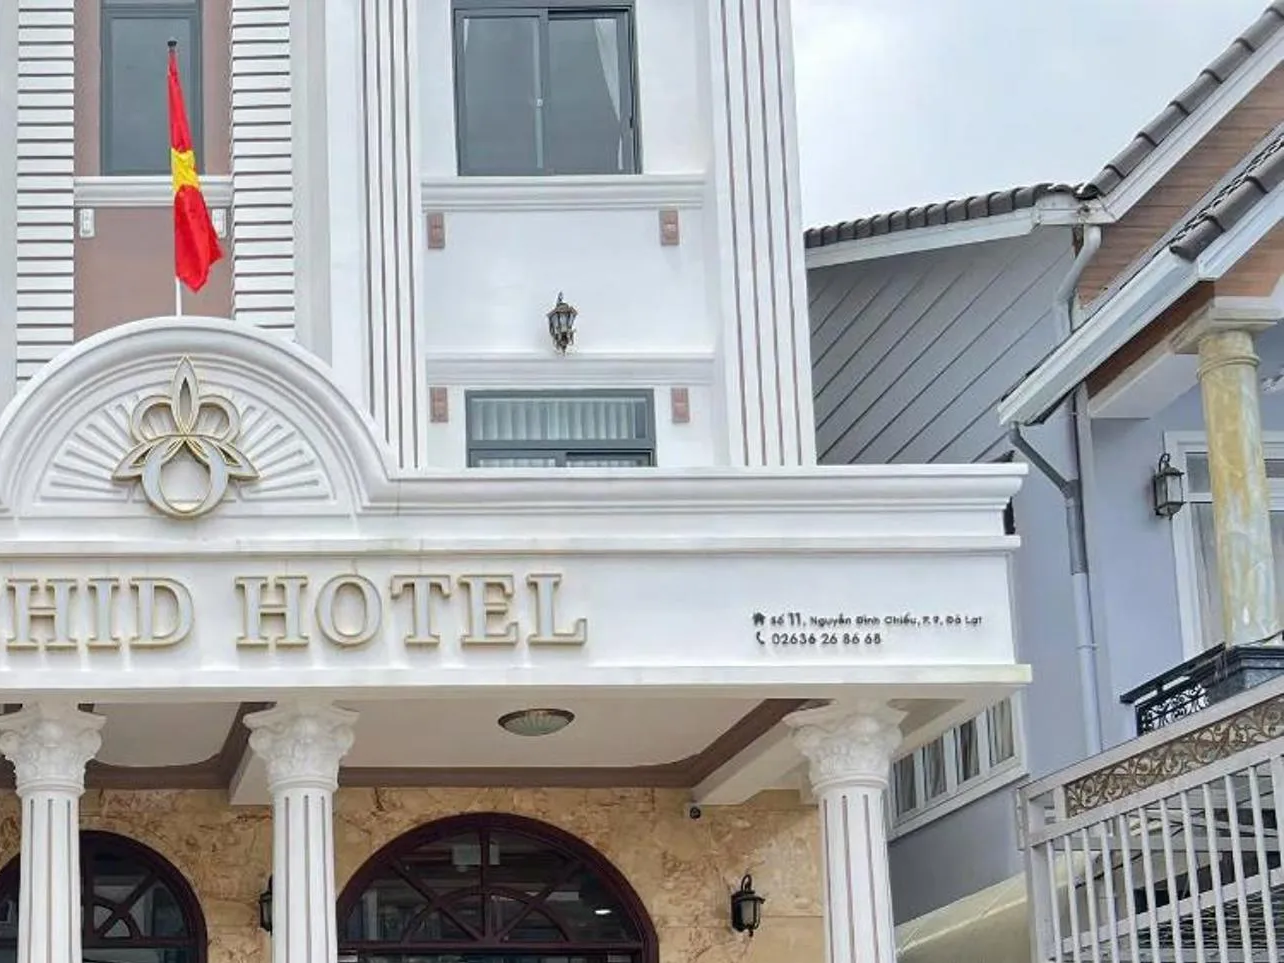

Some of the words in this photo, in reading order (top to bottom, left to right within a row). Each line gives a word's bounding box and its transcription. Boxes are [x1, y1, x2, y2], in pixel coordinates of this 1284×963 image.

[235, 572, 588, 647] HOTEL
[771, 632, 817, 646] 02636
[821, 632, 838, 645] 26
[842, 633, 860, 645] 86
[864, 633, 881, 645] 68
